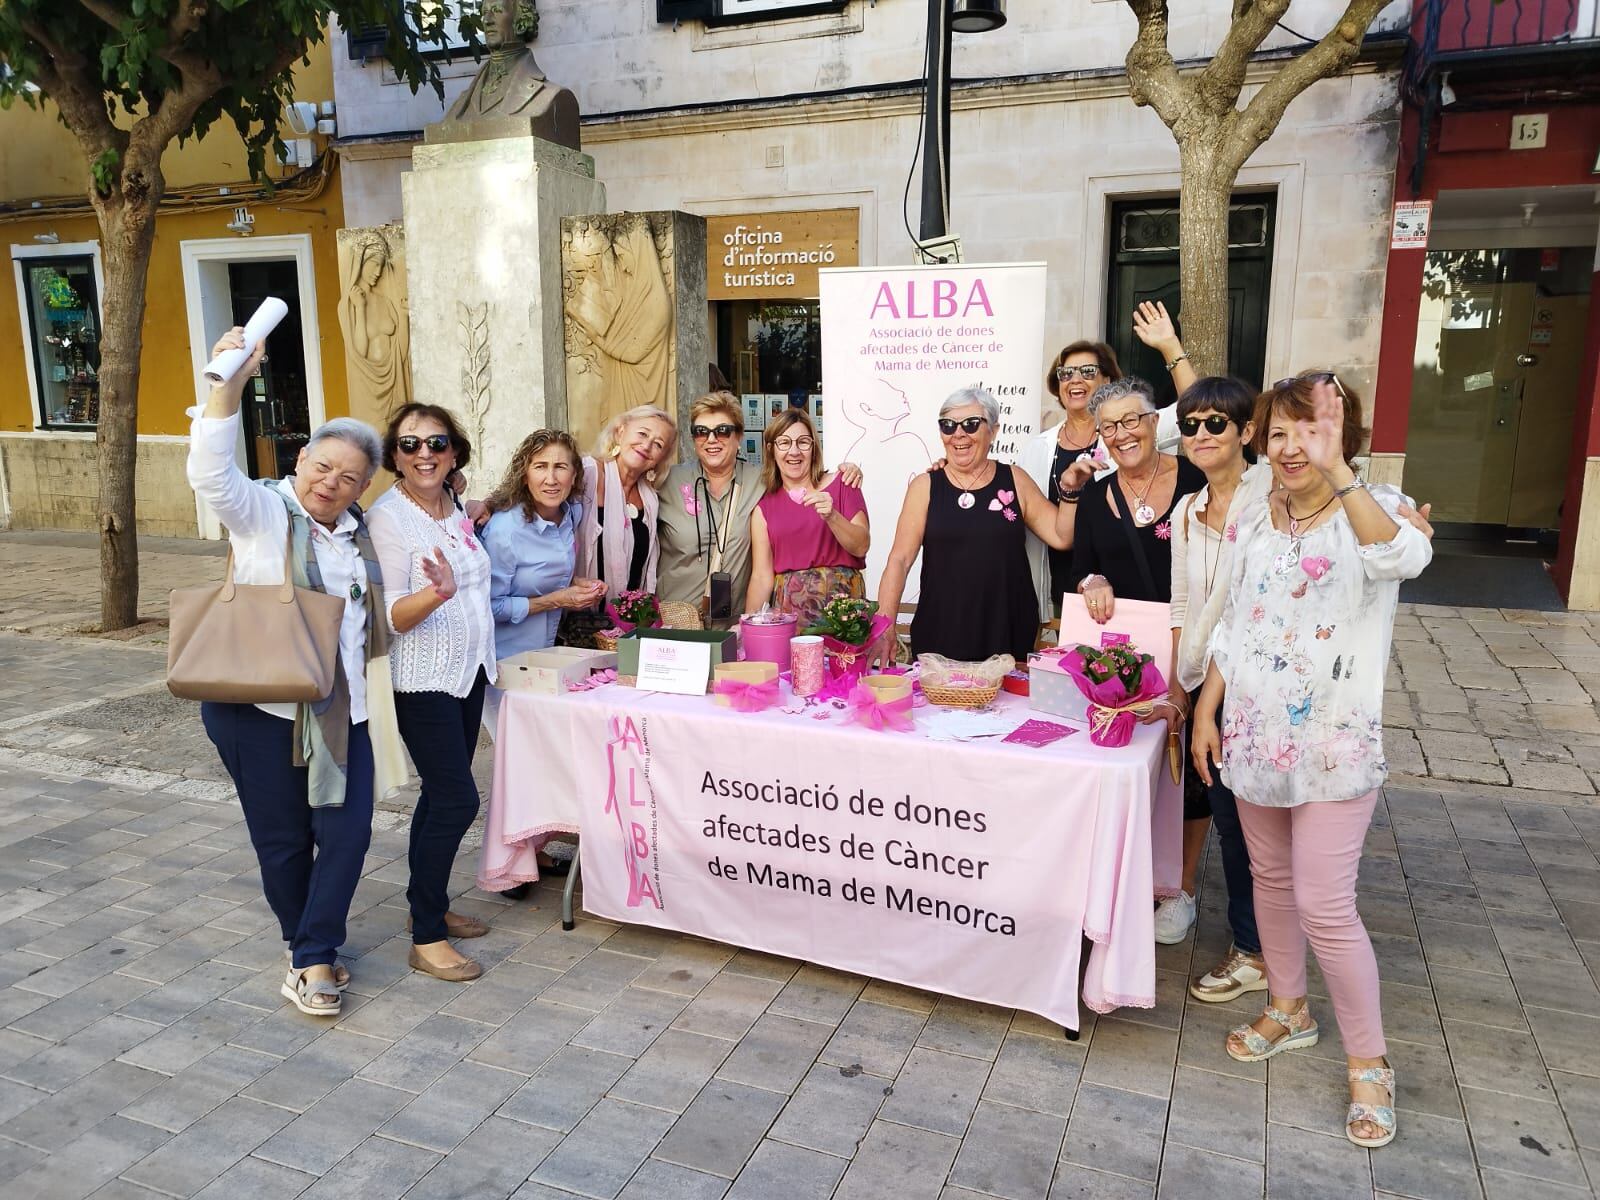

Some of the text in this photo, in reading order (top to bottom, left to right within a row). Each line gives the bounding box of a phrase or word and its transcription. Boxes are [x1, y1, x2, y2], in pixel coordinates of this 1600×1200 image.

[1517, 122, 1540, 141] 15
[723, 226, 783, 247] oficina
[723, 243, 835, 267] d'informació
[723, 267, 796, 288] turística
[869, 278, 995, 320] ALBA
[869, 324, 995, 339] Associació de dones
[859, 341, 1004, 356] afectades de Càncer de
[874, 358, 989, 372] Mama de Menorca
[997, 384, 1028, 396] teva
[1002, 423, 1033, 435] teva
[700, 771, 987, 833] Associació de dones
[651, 820, 659, 852] afectades
[702, 814, 990, 880] afectades de Càncer
[652, 853, 660, 872] dones
[707, 856, 1017, 937] de Mama de Menorca
